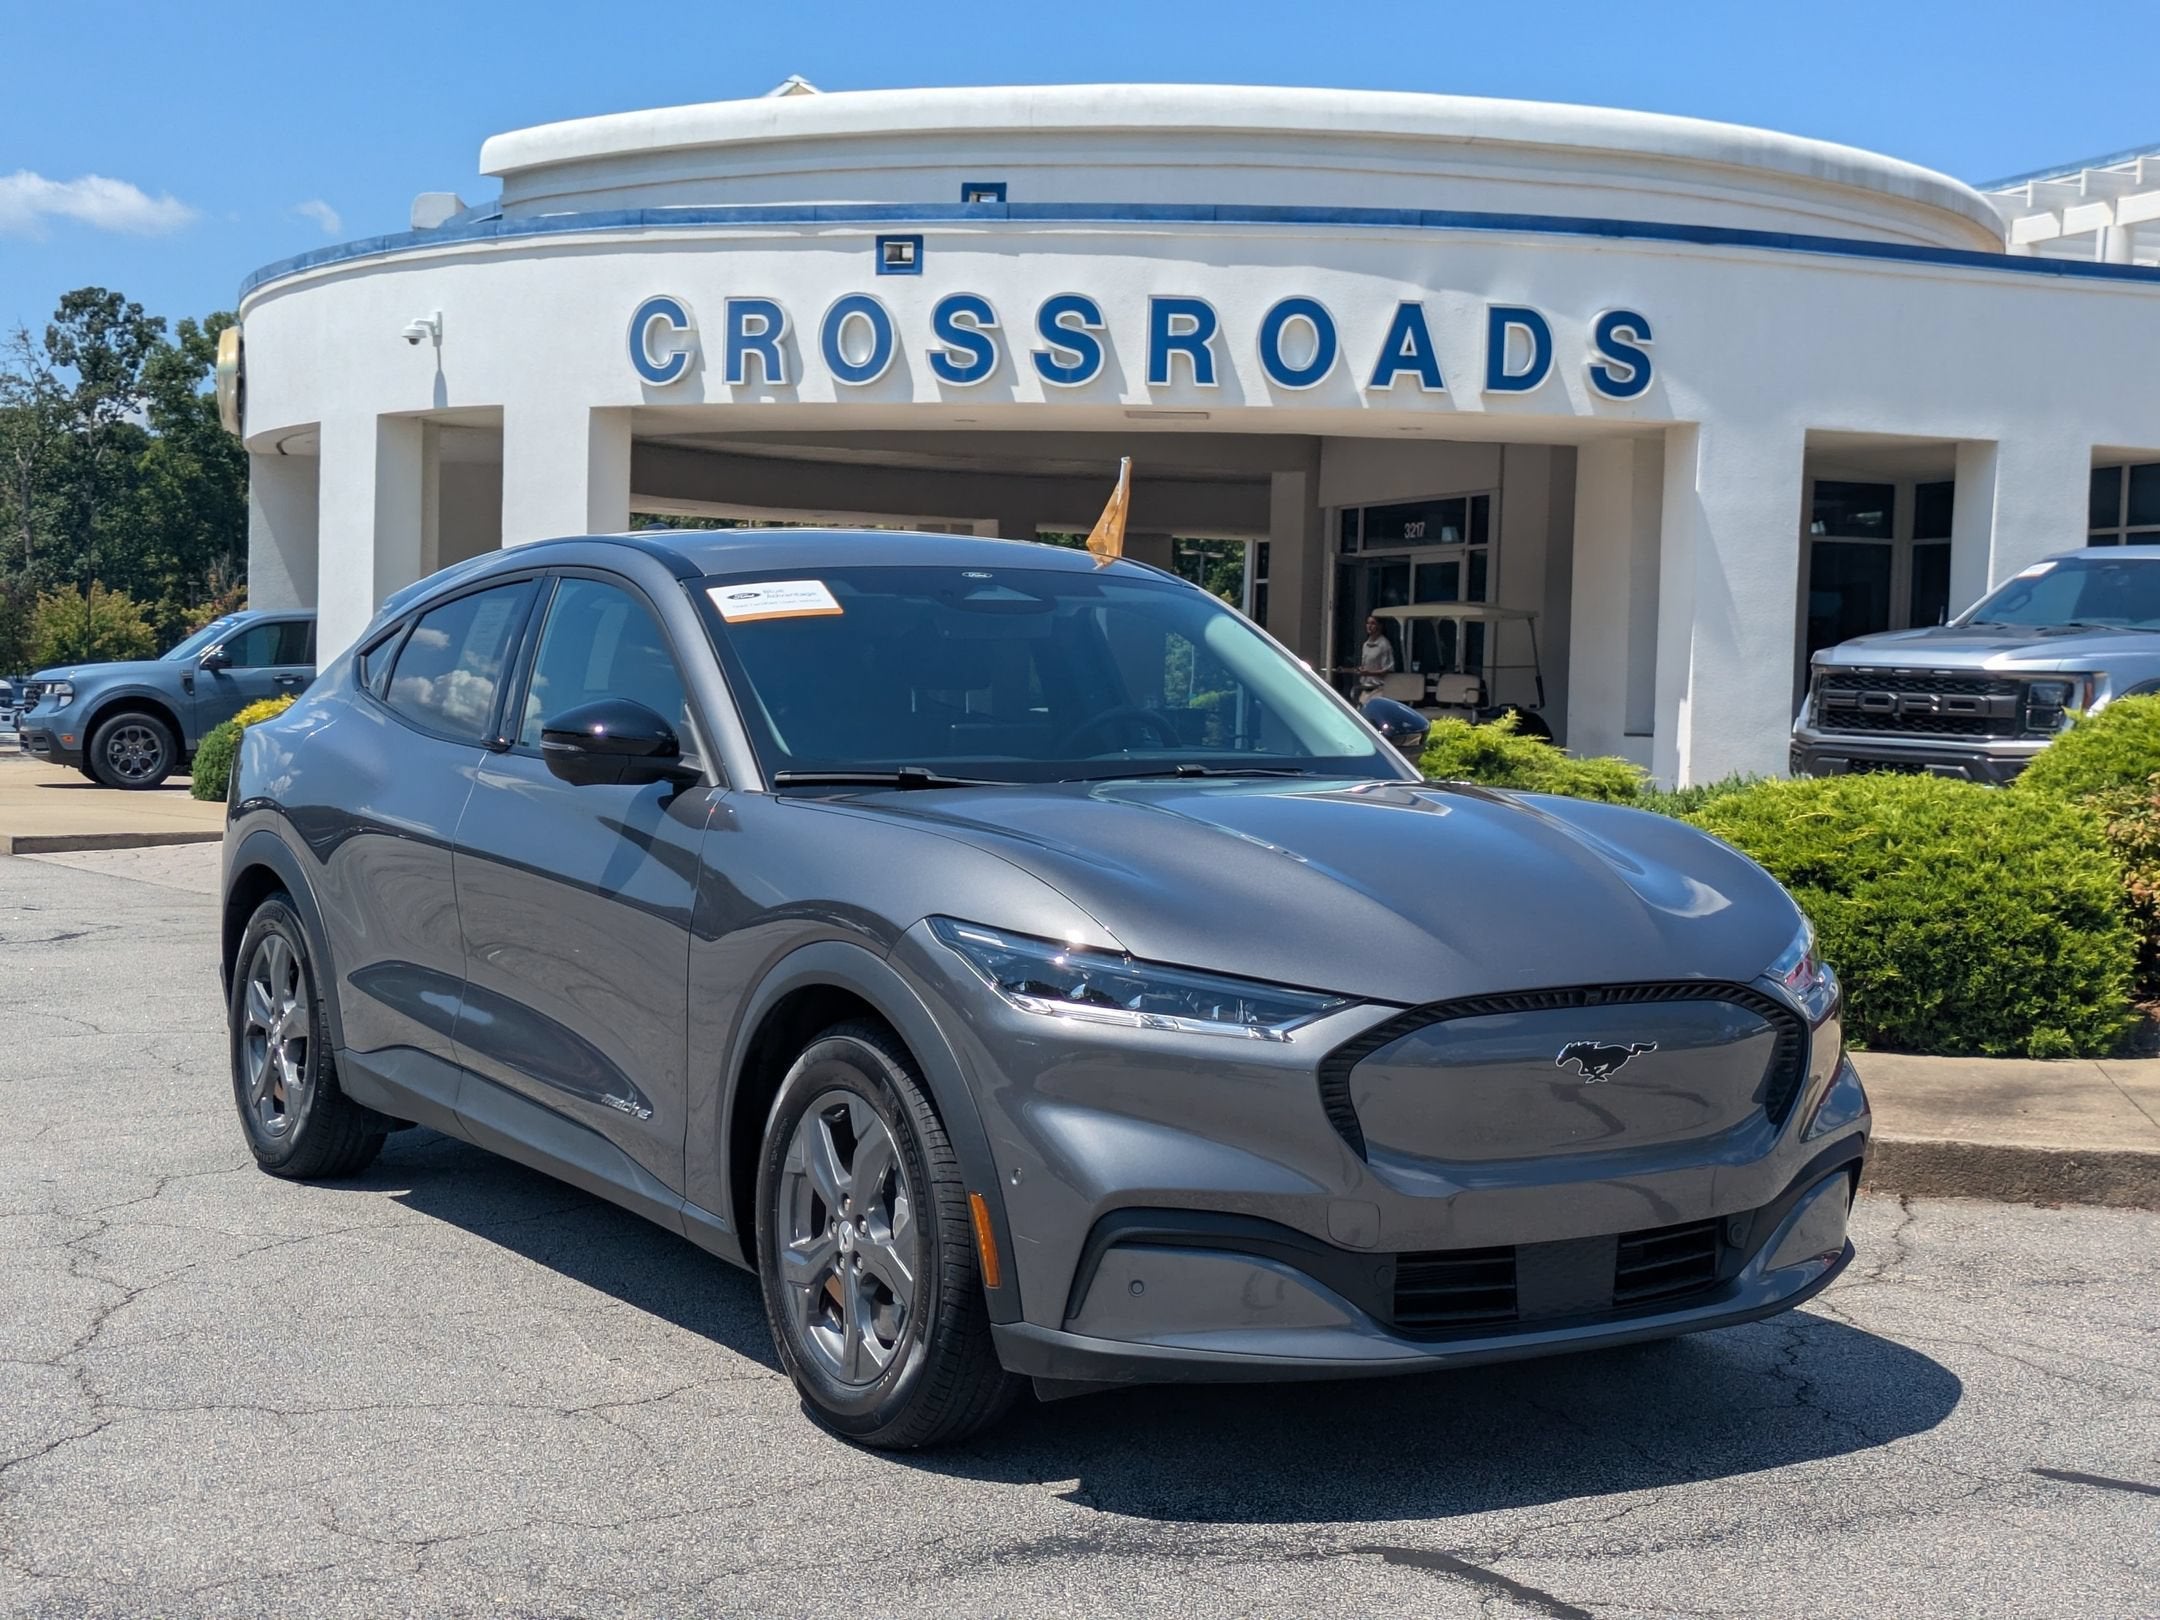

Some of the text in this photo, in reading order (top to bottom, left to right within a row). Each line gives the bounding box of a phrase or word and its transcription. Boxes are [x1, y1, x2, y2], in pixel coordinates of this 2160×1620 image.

[628, 291, 1655, 400] CROSSROADS
[1404, 521, 1425, 539] 3217
[1822, 690, 1989, 716] FORD
